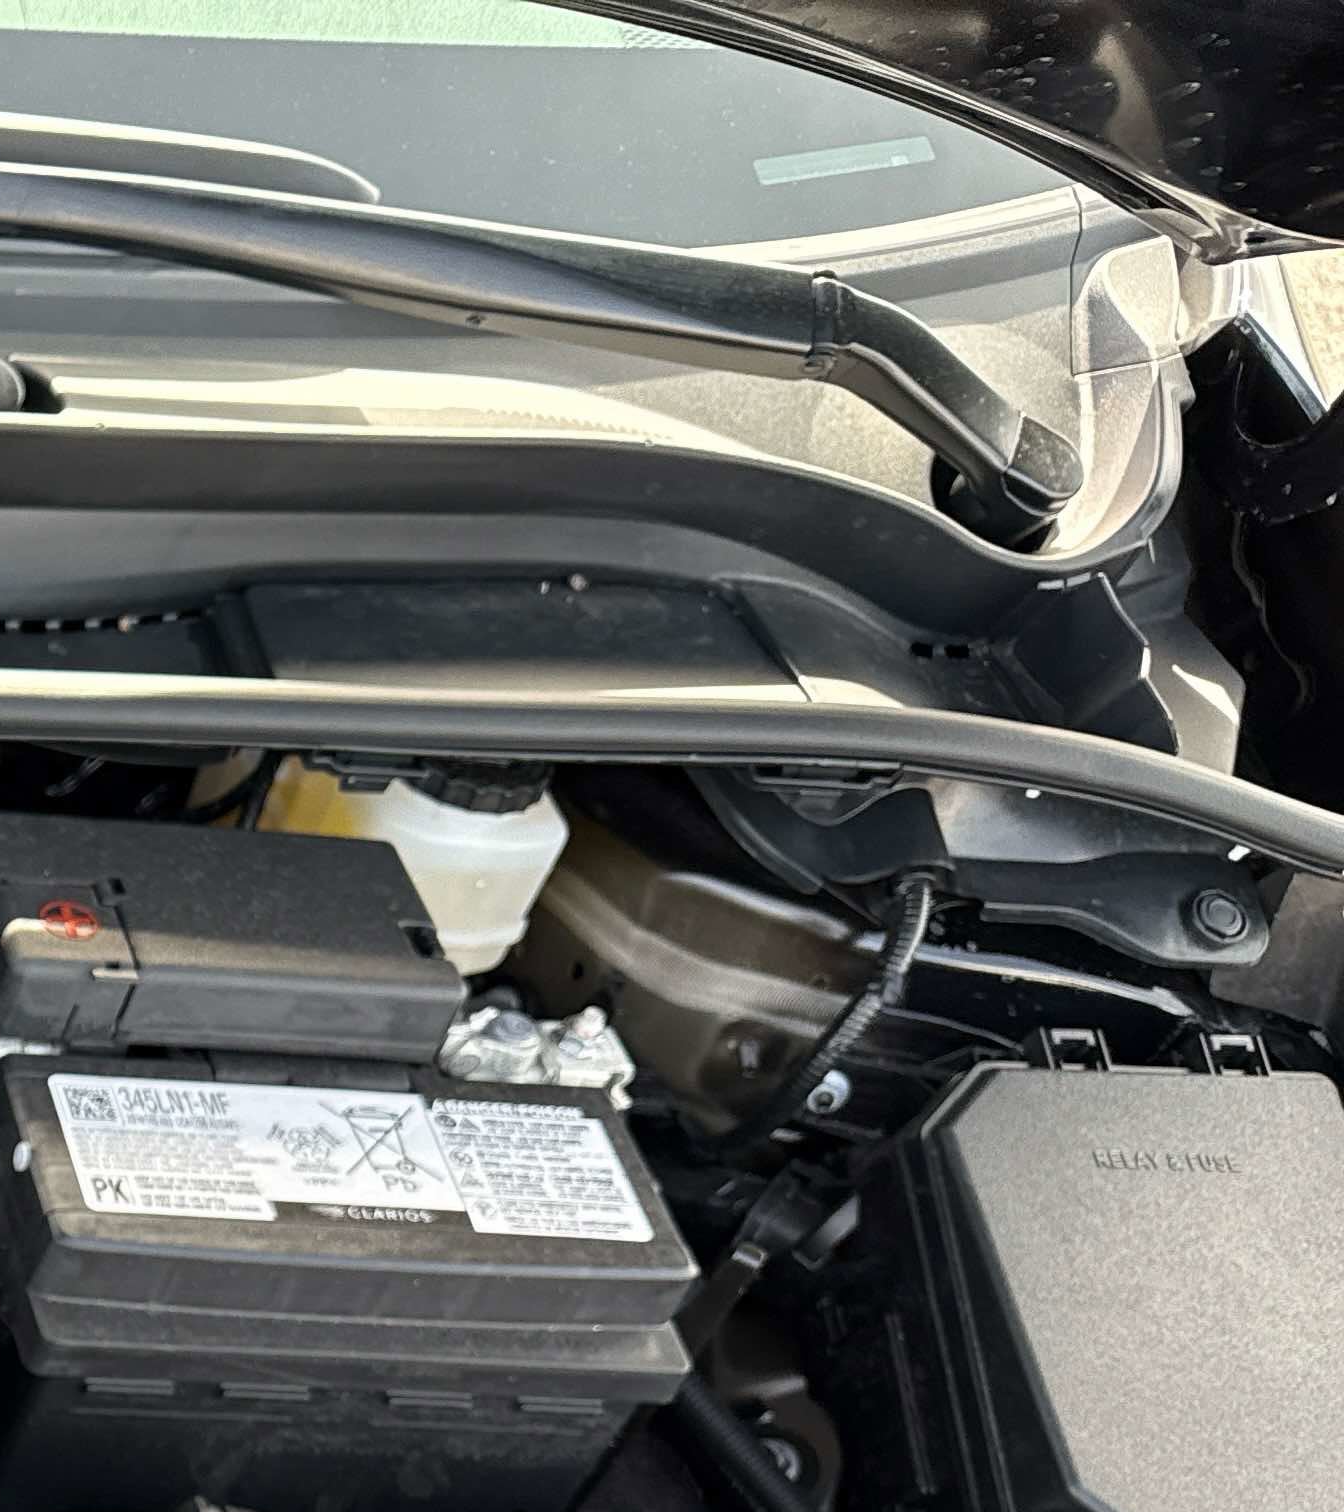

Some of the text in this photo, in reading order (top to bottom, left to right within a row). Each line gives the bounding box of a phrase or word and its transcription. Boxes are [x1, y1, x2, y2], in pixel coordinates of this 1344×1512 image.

[1093, 1151, 1158, 1171] RELAY
[1185, 1154, 1242, 1174] FUSE
[92, 1177, 128, 1202] PK
[347, 1206, 433, 1224] CLARIOS
